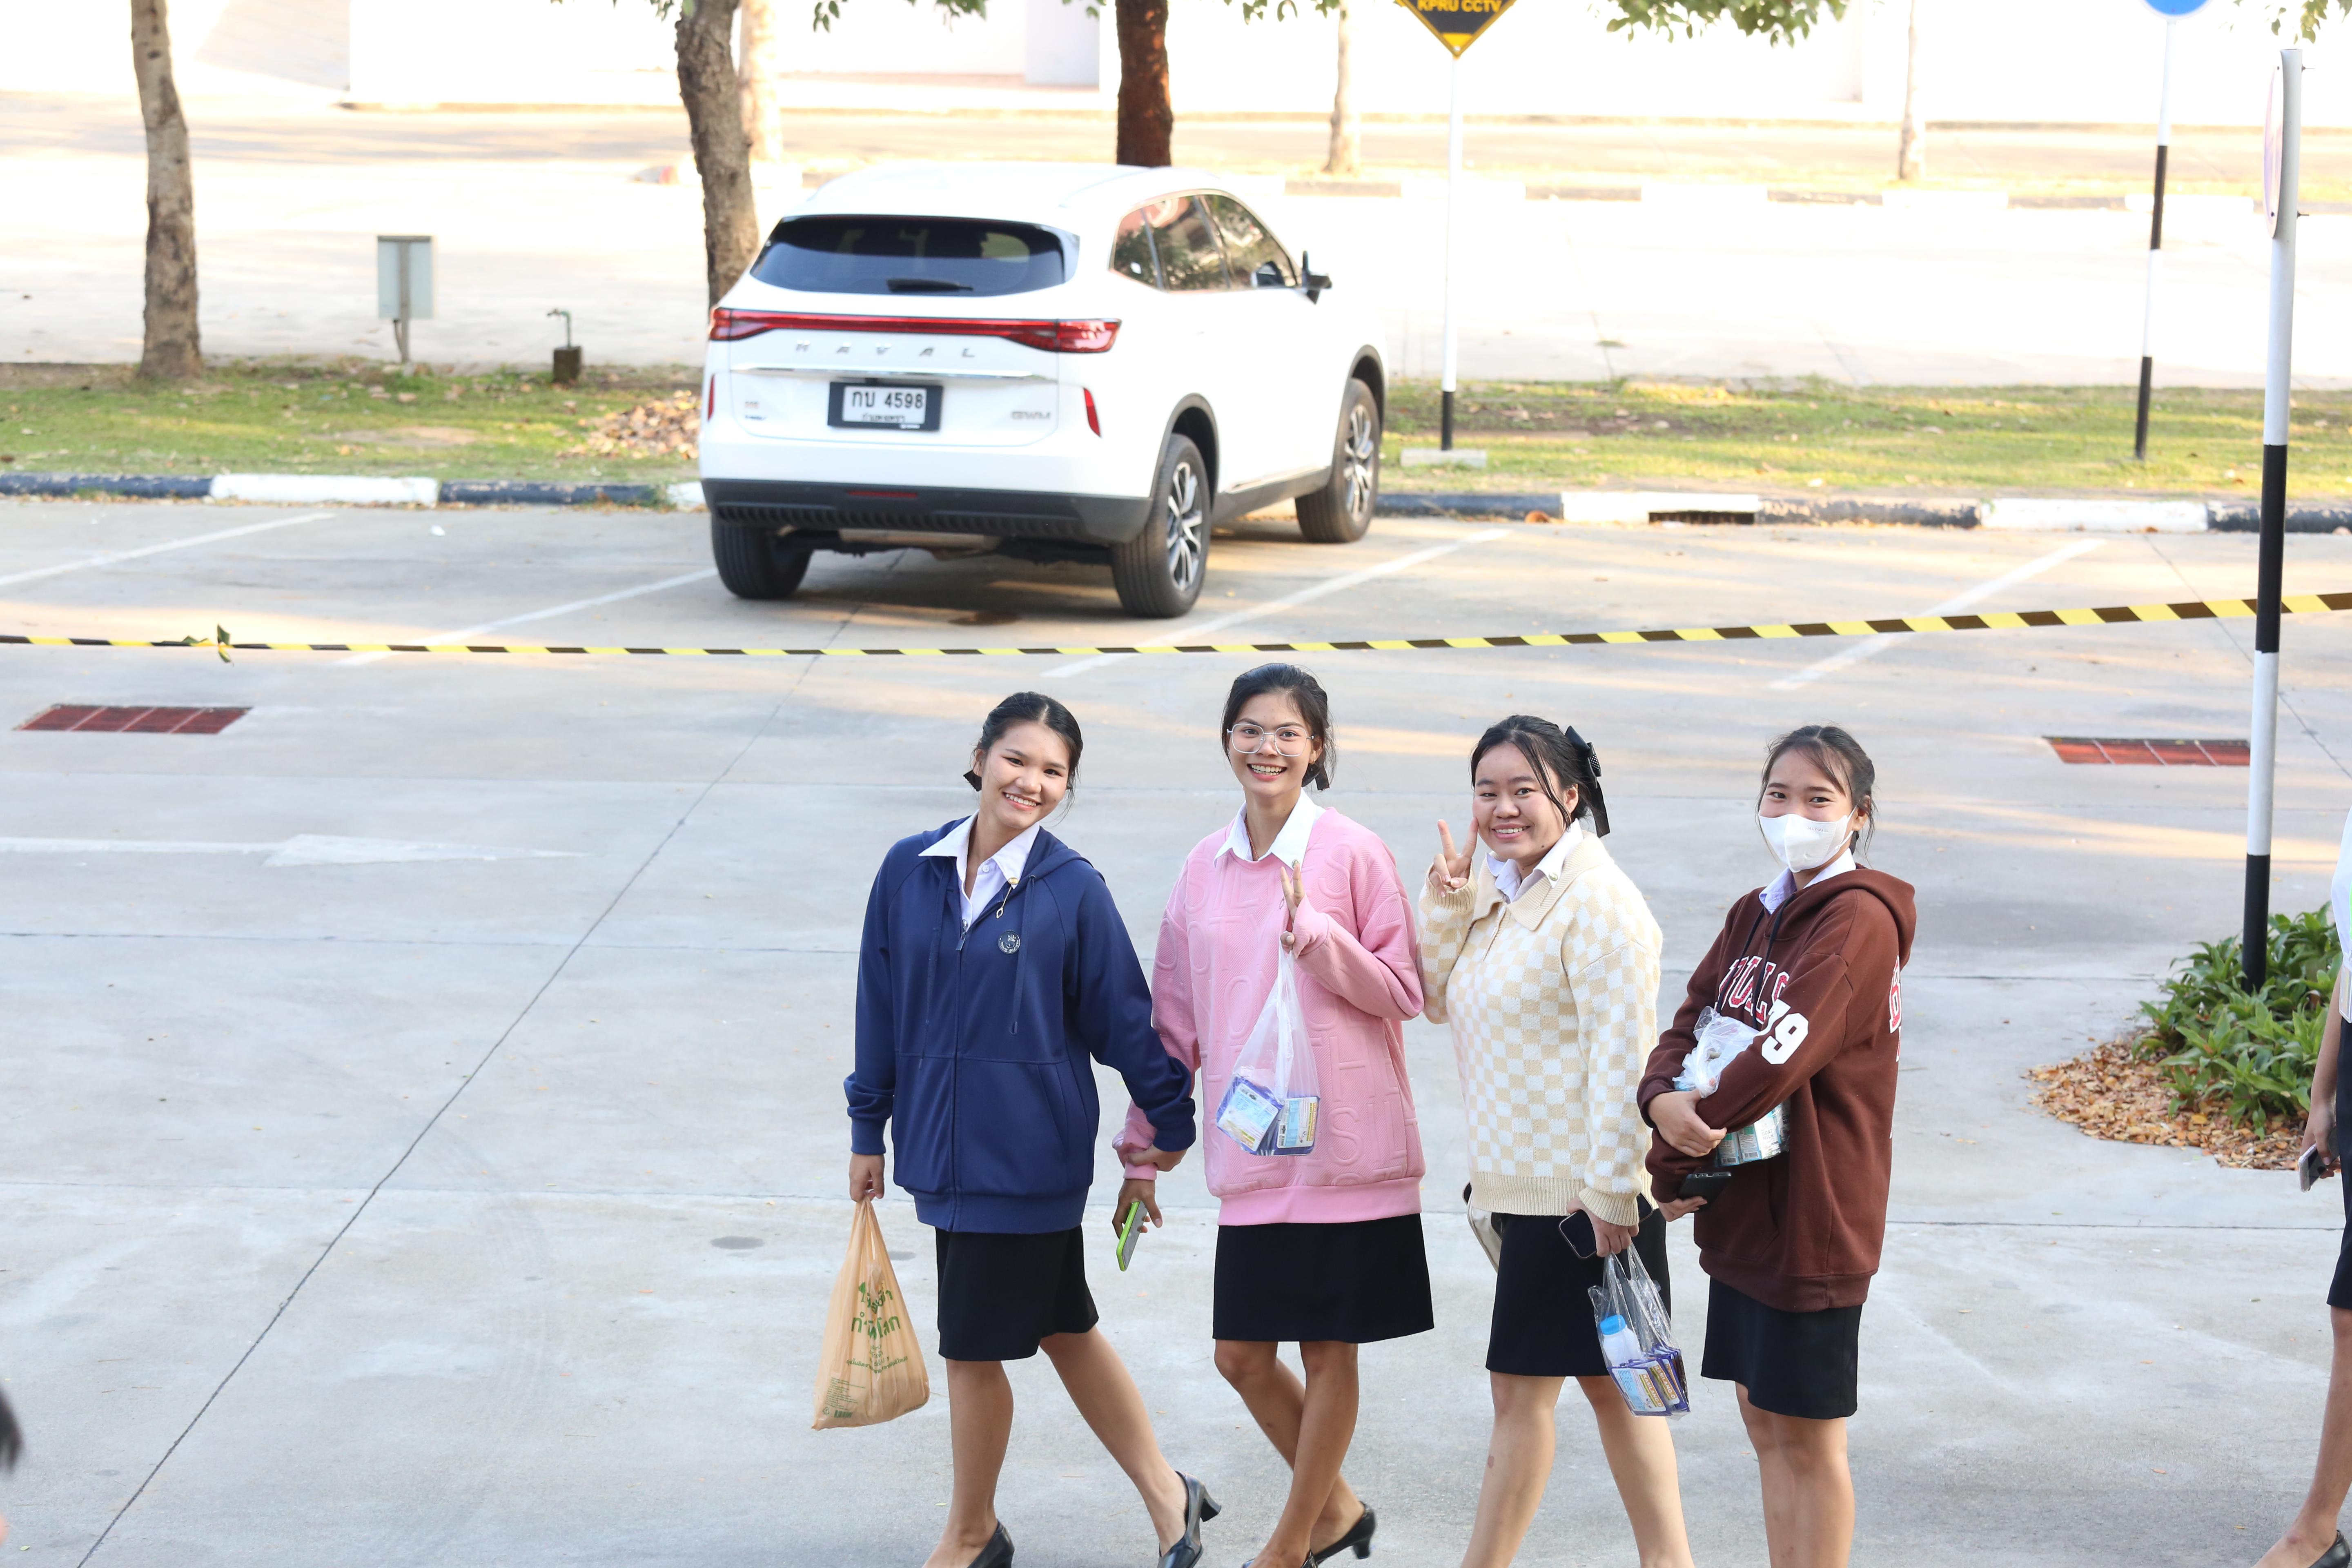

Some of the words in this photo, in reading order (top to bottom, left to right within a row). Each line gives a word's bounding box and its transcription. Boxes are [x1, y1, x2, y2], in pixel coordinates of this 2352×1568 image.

[1417, 0, 1459, 11] KPRU
[1461, 0, 1501, 12] CCTV
[796, 341, 975, 357] HAVAL
[885, 392, 923, 409] 4598
[1754, 998, 1809, 1065] 79
[1642, 1374, 1662, 1407] KAMLANG-D
[1654, 1365, 1675, 1399] KAMLANG-D
